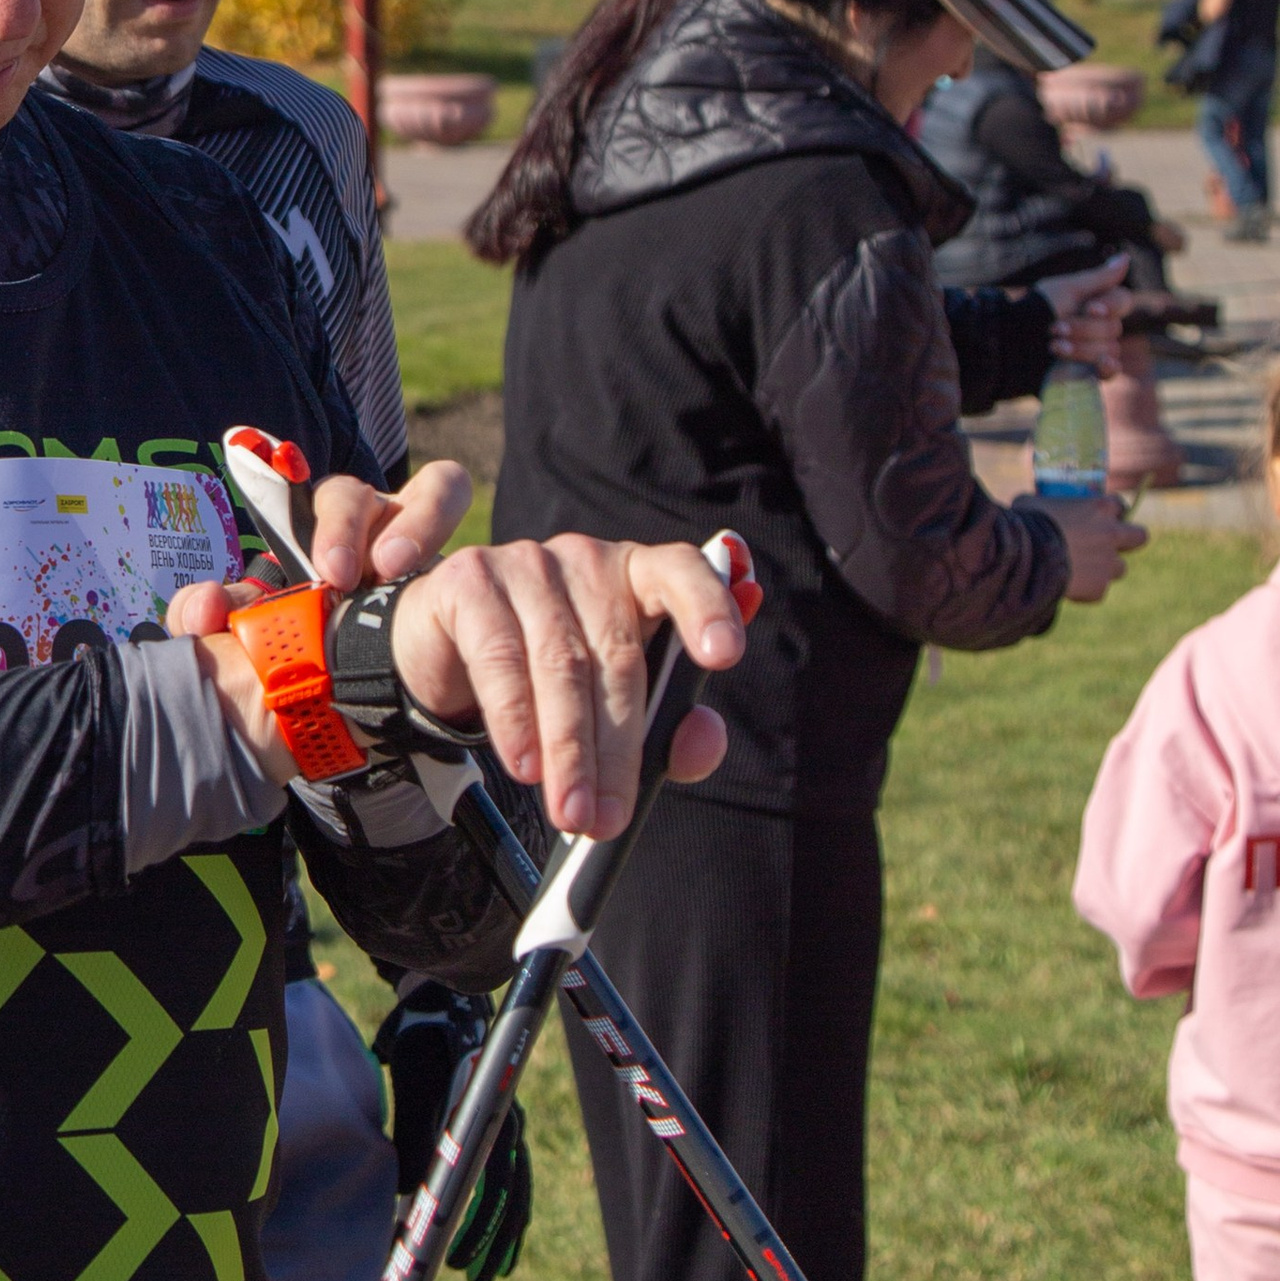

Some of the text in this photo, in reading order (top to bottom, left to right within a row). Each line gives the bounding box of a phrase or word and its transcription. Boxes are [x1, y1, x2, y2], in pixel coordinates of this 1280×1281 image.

[148, 534, 212, 552] ВСЕРОССИЙСКИЙ
[151, 550, 214, 572] ДЕНЬ ХОДЬБЫ
